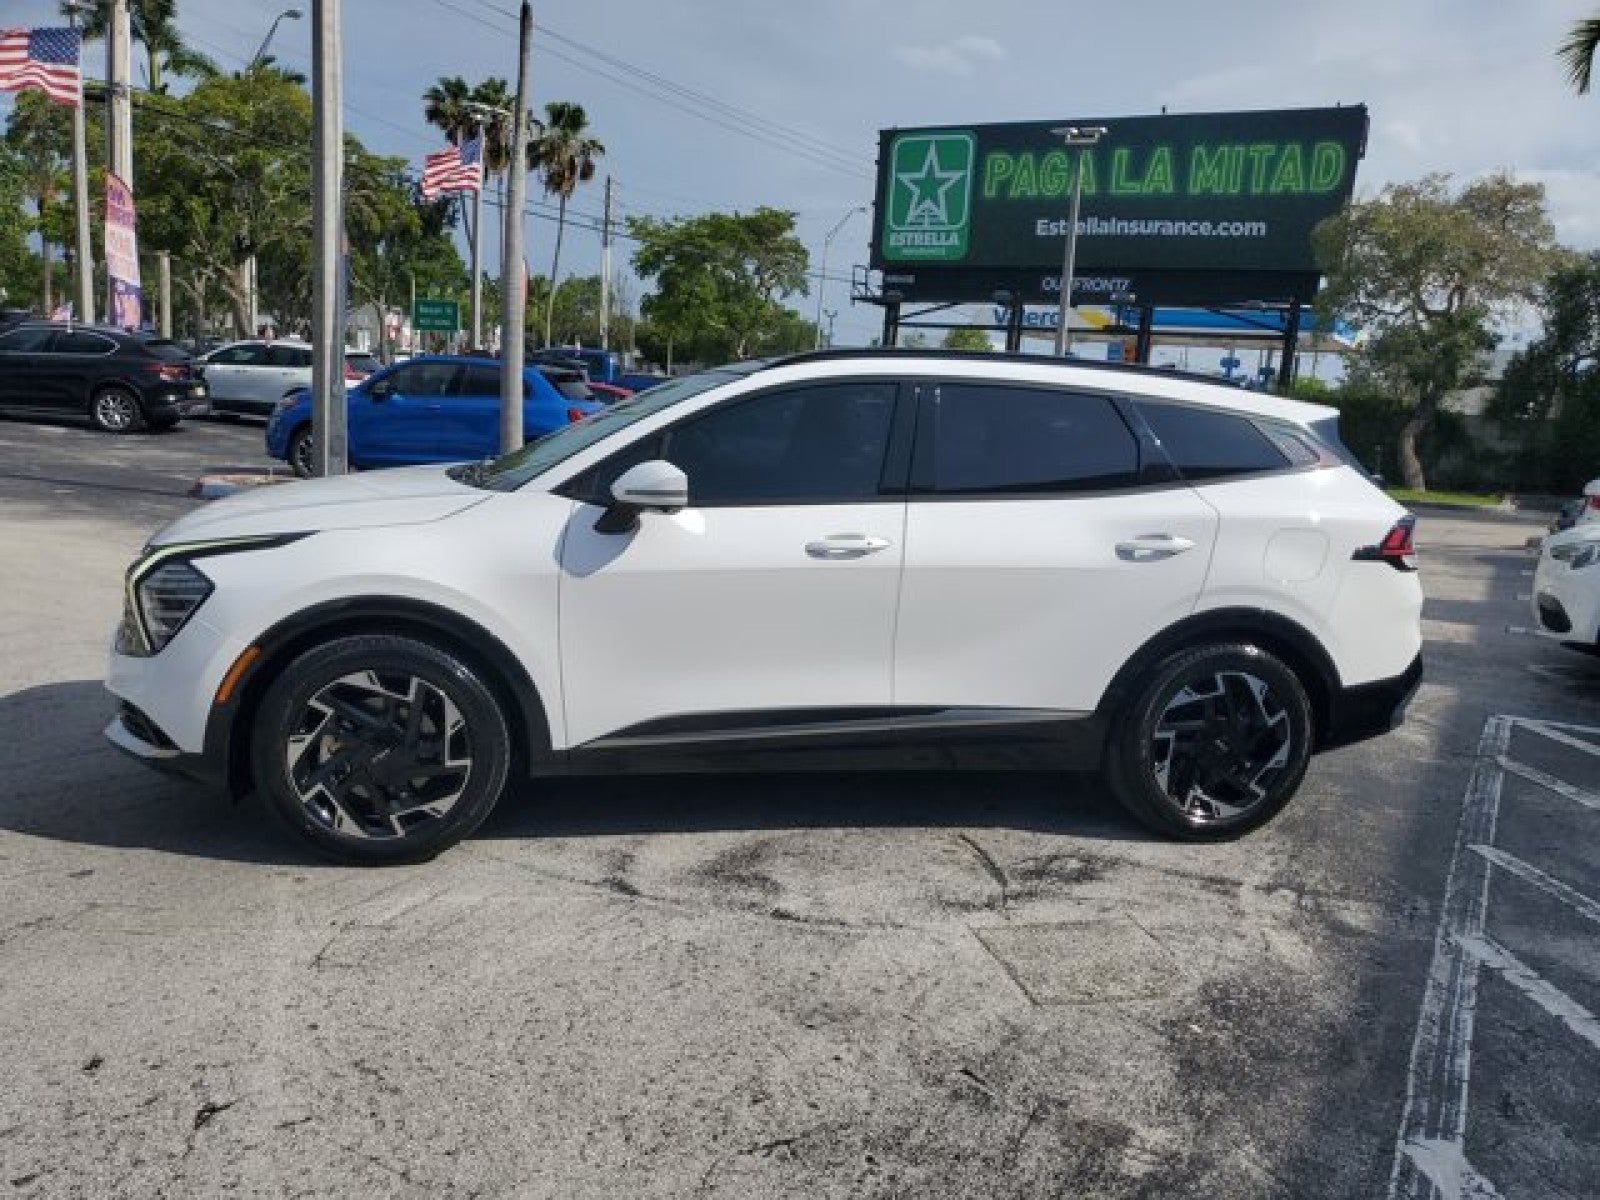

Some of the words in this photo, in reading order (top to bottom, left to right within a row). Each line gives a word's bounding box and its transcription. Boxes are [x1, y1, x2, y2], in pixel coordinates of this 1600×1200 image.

[984, 151, 1096, 197] PAGA
[1111, 147, 1174, 194] LA
[1189, 142, 1346, 194] MITAD
[1035, 217, 1266, 236] EstellaInsurance.com
